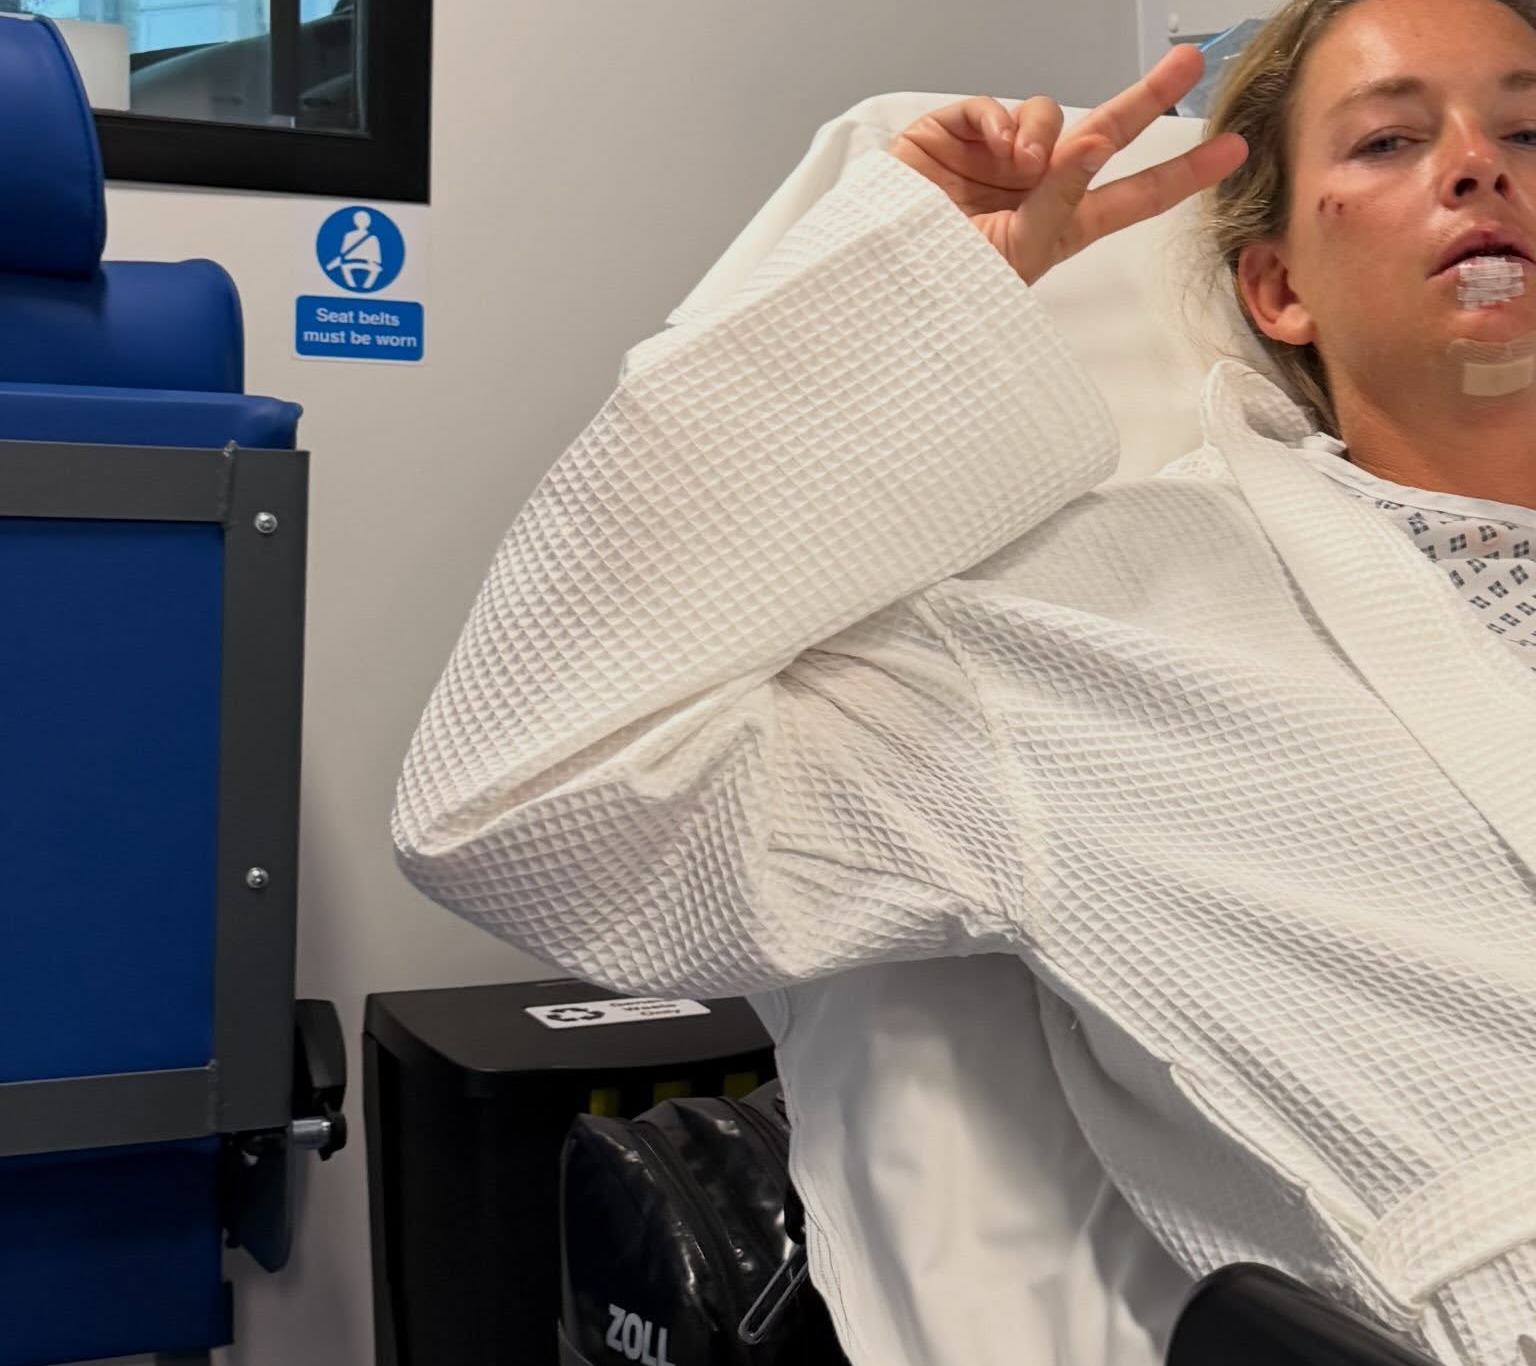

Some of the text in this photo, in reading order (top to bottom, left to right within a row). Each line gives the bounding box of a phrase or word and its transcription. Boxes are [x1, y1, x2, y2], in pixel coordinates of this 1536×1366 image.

[315, 307, 401, 327] Seat belts
[303, 330, 418, 348] must be worn
